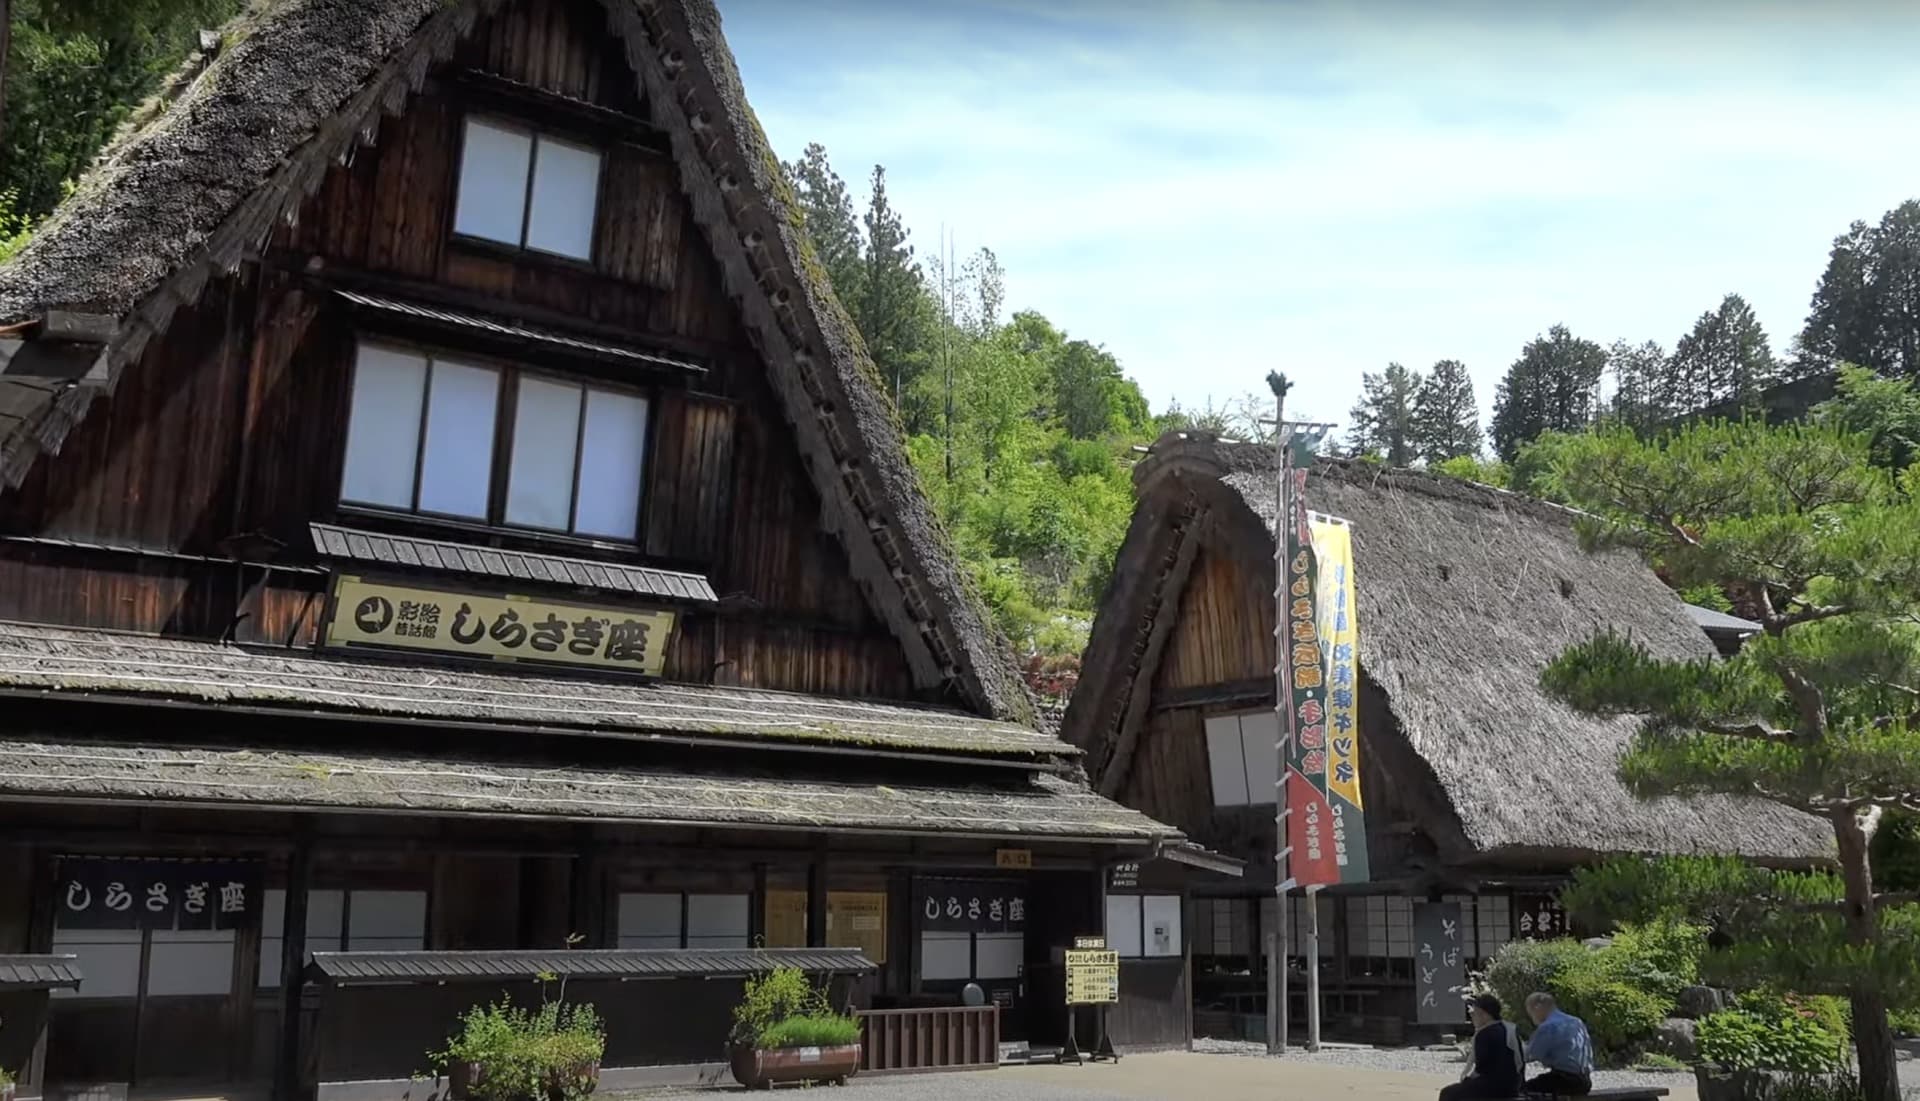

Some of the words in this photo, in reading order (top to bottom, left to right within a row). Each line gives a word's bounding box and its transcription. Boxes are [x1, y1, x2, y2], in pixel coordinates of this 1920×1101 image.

[397, 600, 441, 624] 影絵
[395, 622, 437, 639] 昔話館
[450, 602, 650, 663] しらさぎ座
[1001, 853, 1027, 864] 入口
[66, 879, 247, 913] しらさぎ座
[925, 895, 1024, 922] しらさぎ座
[1442, 918, 1460, 967] そば
[1083, 953, 1115, 963] しらさぎ座
[1421, 943, 1438, 1007] うどん
